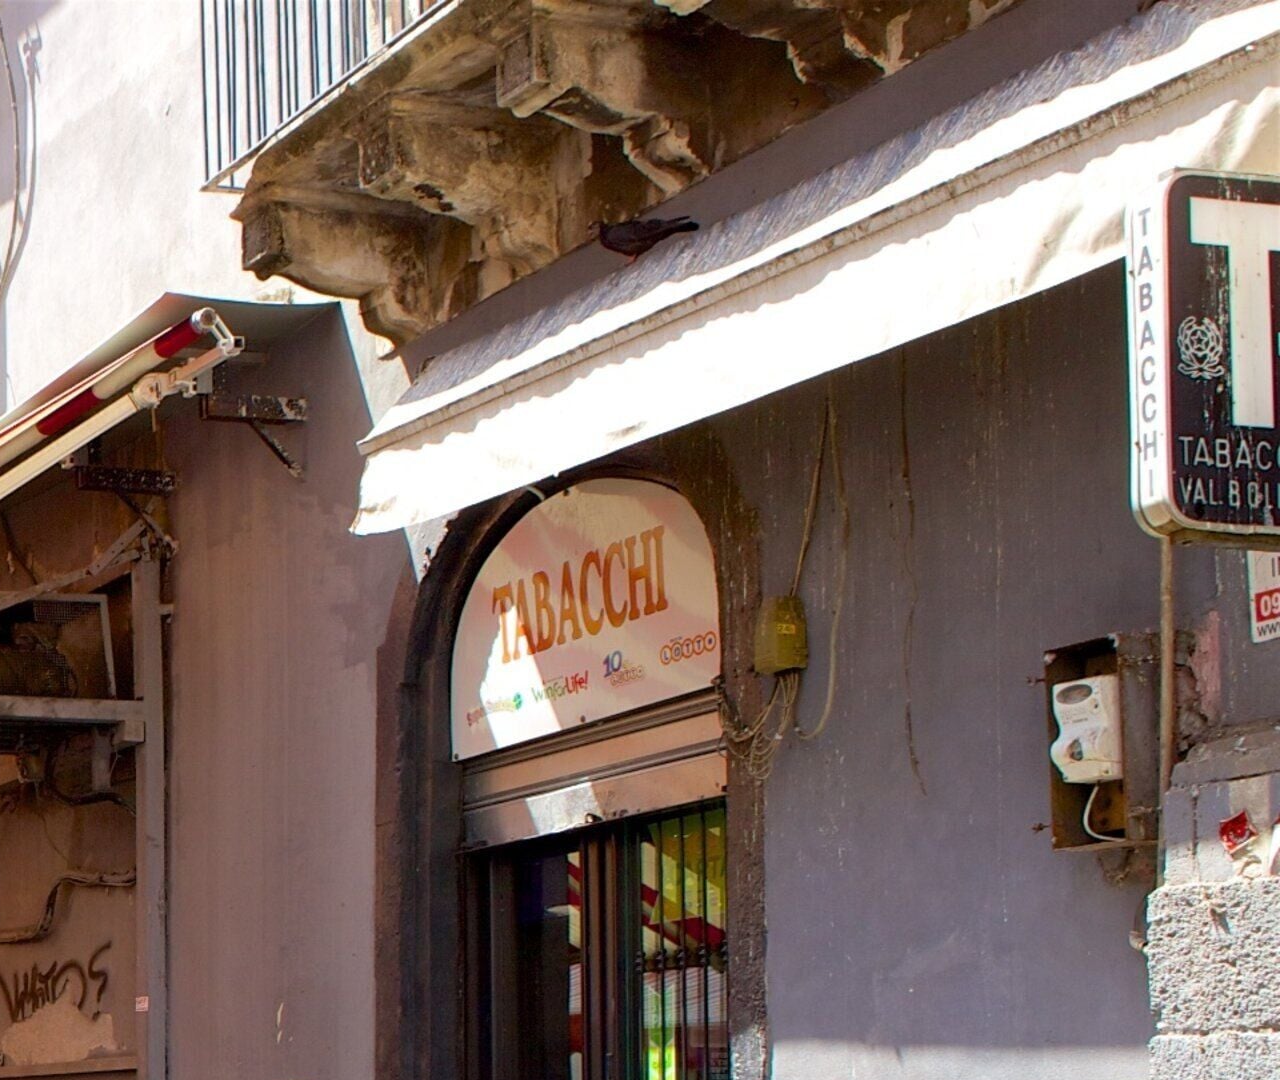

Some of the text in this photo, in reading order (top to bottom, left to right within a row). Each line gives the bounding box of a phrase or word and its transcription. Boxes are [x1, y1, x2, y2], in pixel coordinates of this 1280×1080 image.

[1138, 207, 1158, 498] TABACCHI
[1178, 436, 1280, 471] TABAC
[492, 525, 669, 665] TABACCHI
